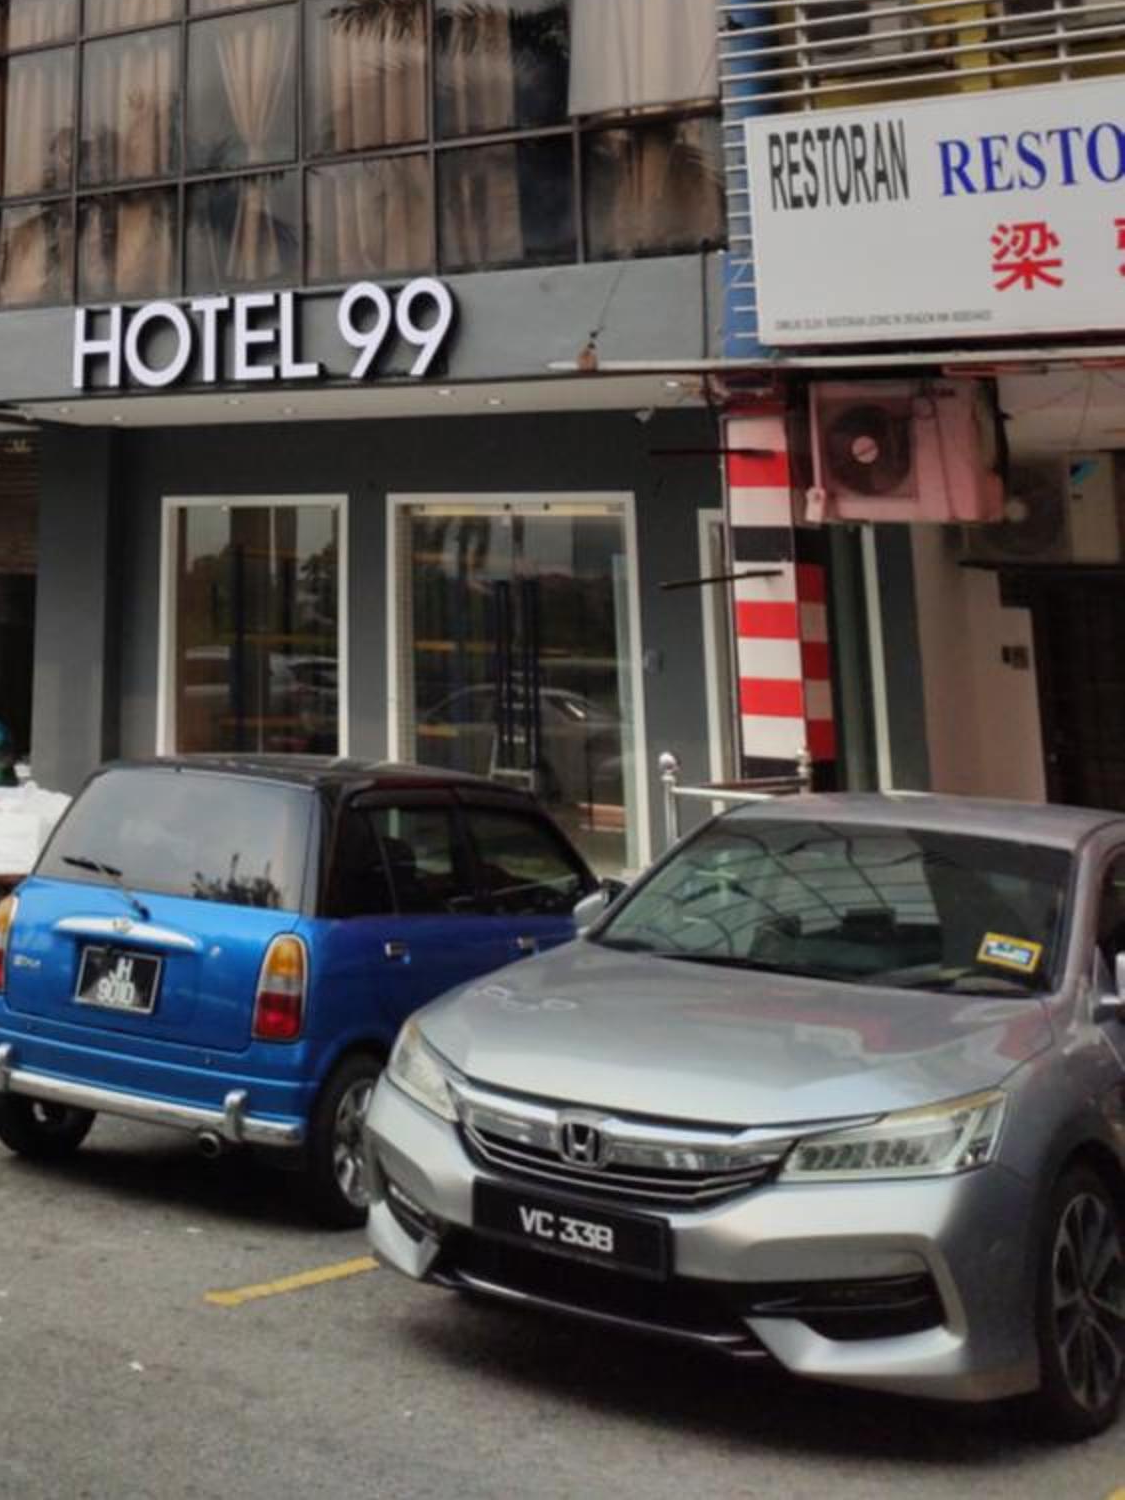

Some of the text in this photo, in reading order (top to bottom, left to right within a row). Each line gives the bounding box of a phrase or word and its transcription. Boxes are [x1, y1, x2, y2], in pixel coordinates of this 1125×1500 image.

[768, 119, 1125, 212] RESTORAN RESTO
[73, 277, 455, 389] HOTEL 99
[519, 1205, 614, 1252] VC 338
